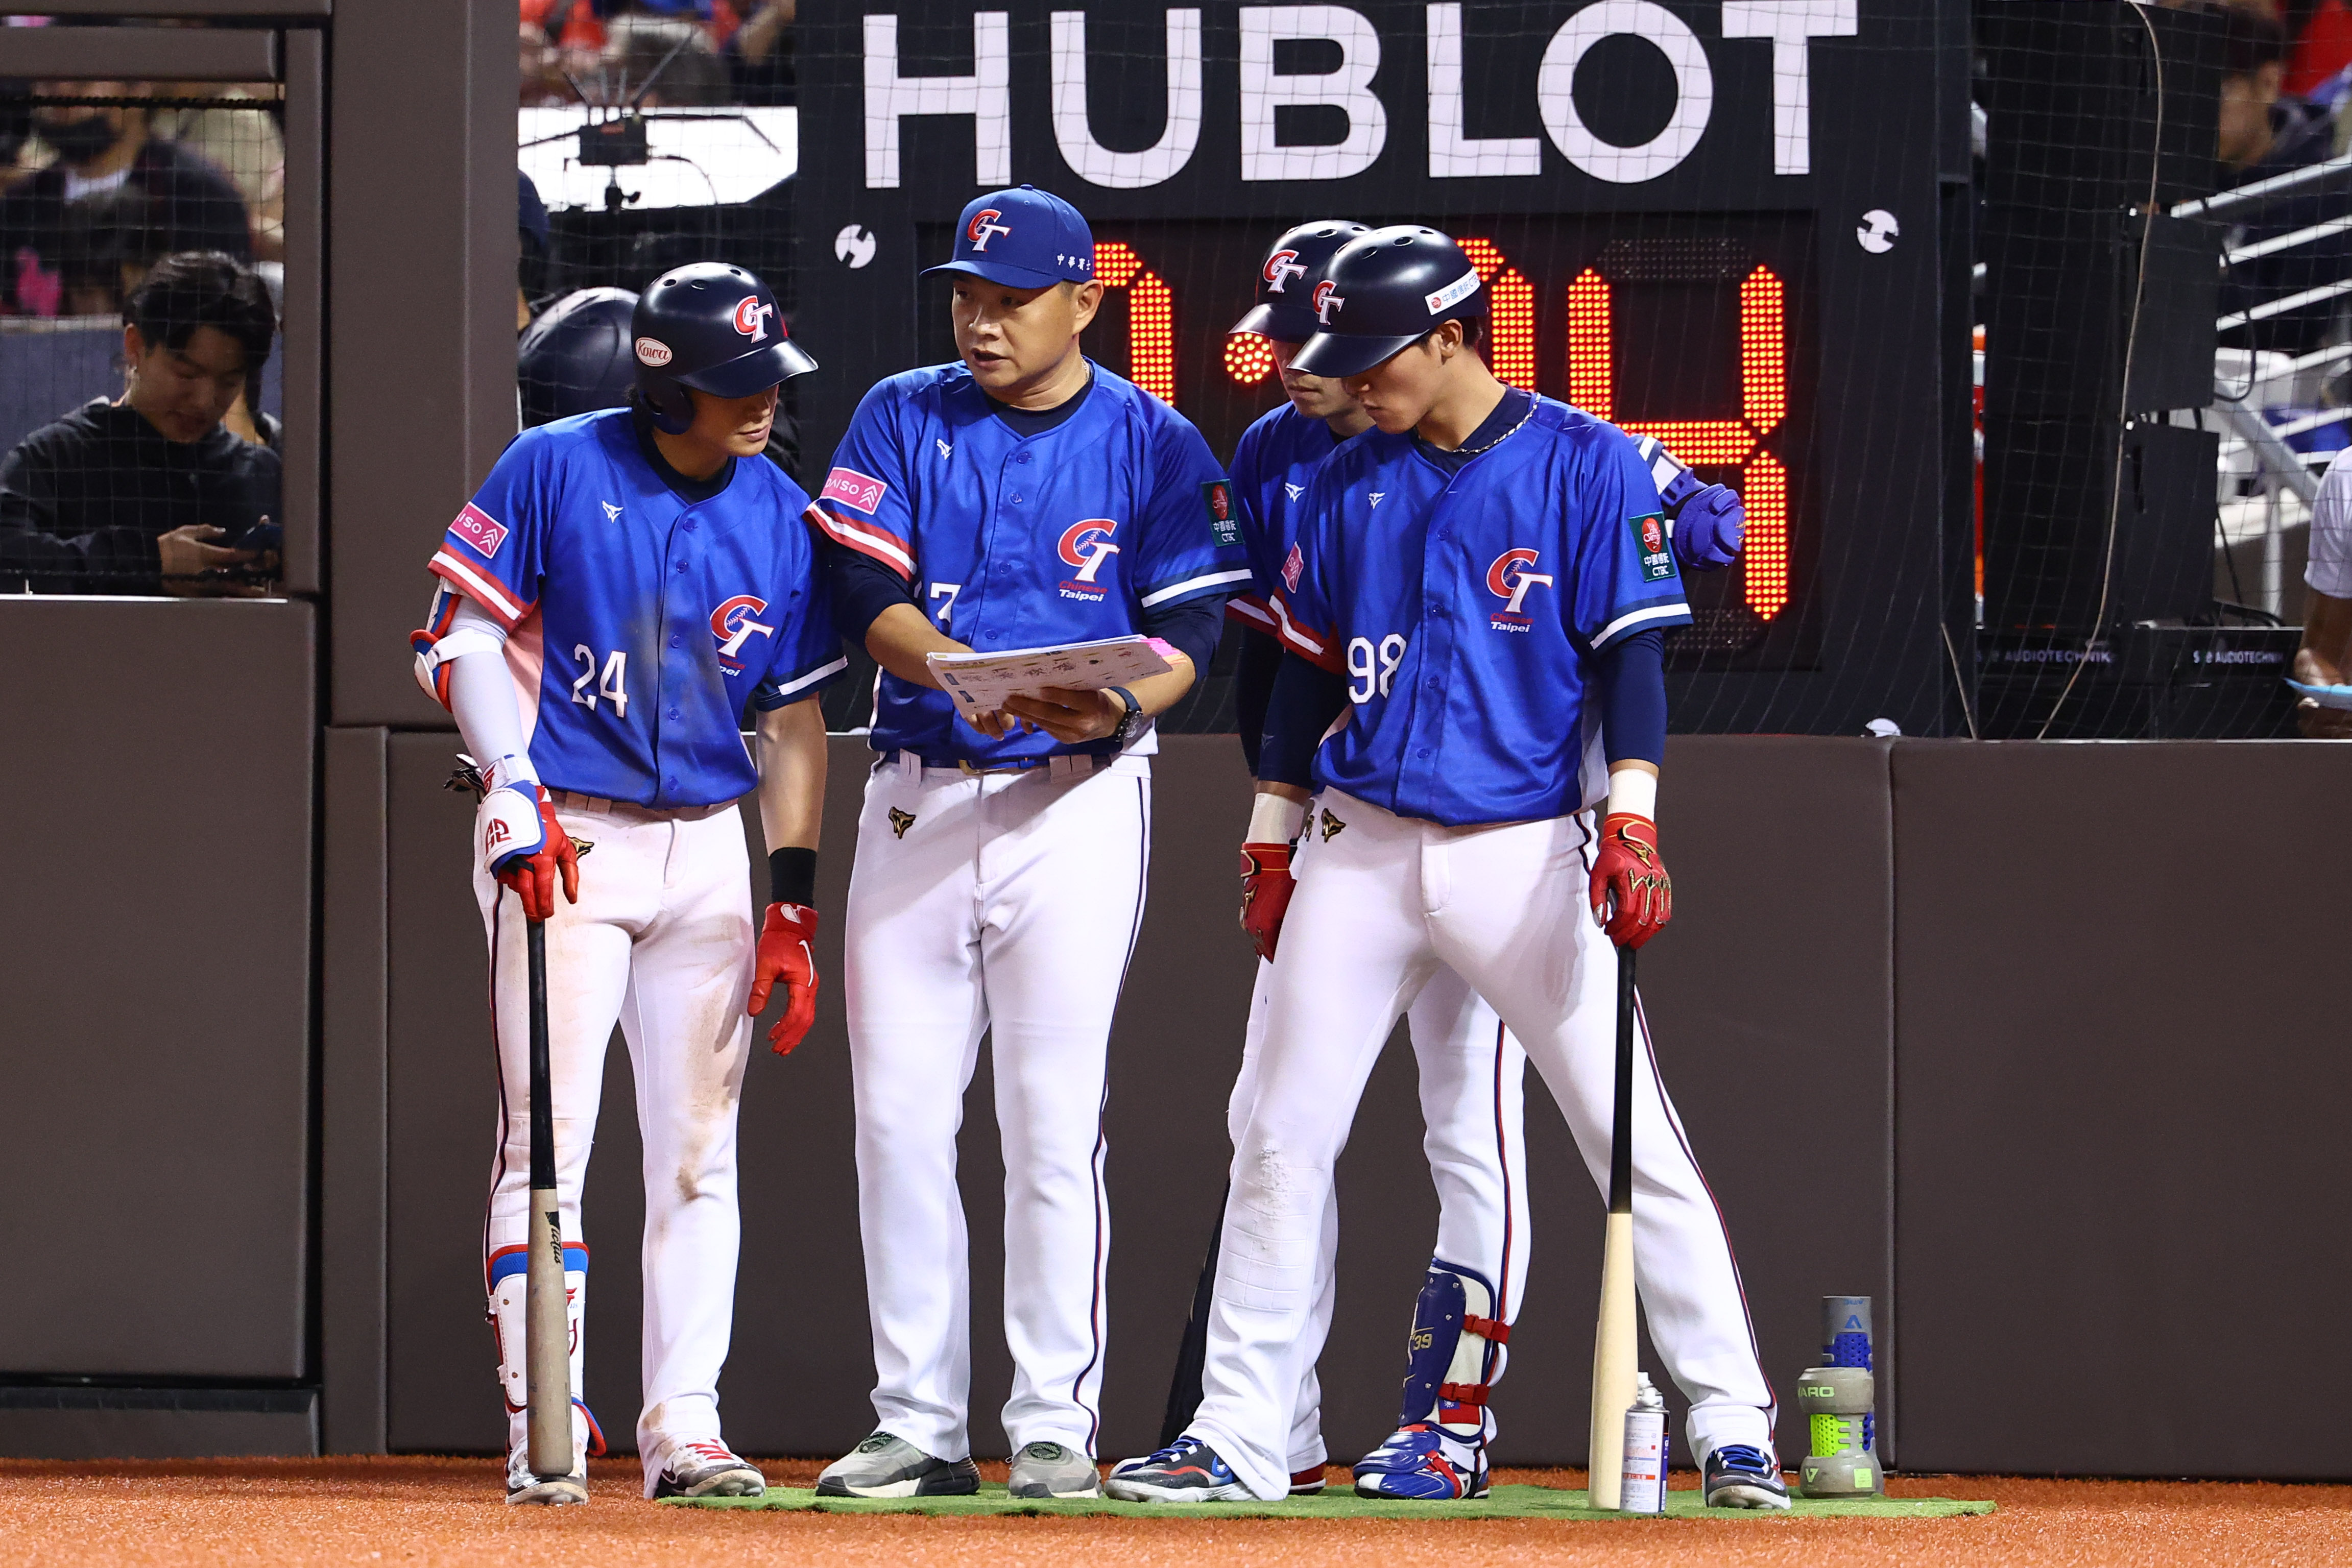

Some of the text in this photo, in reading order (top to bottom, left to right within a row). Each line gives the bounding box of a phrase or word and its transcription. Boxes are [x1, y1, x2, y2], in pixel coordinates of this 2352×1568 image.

[863, 0, 1858, 188] HUBLOT
[638, 342, 669, 360] Kowa
[825, 478, 860, 495] DAISO
[456, 512, 483, 534] ISO
[1644, 552, 1670, 567] 中國信託
[1652, 565, 1669, 576] CTBC
[1059, 581, 1109, 594] Chinese
[1059, 589, 1105, 602] Taipei
[1490, 613, 1534, 624] Chinese
[1491, 621, 1530, 633] Taipei
[719, 665, 740, 677] pei
[1348, 634, 1407, 704] 98
[572, 644, 628, 718] 24
[1413, 1333, 1433, 1350] 39
[1798, 1386, 1835, 1397] ARO
